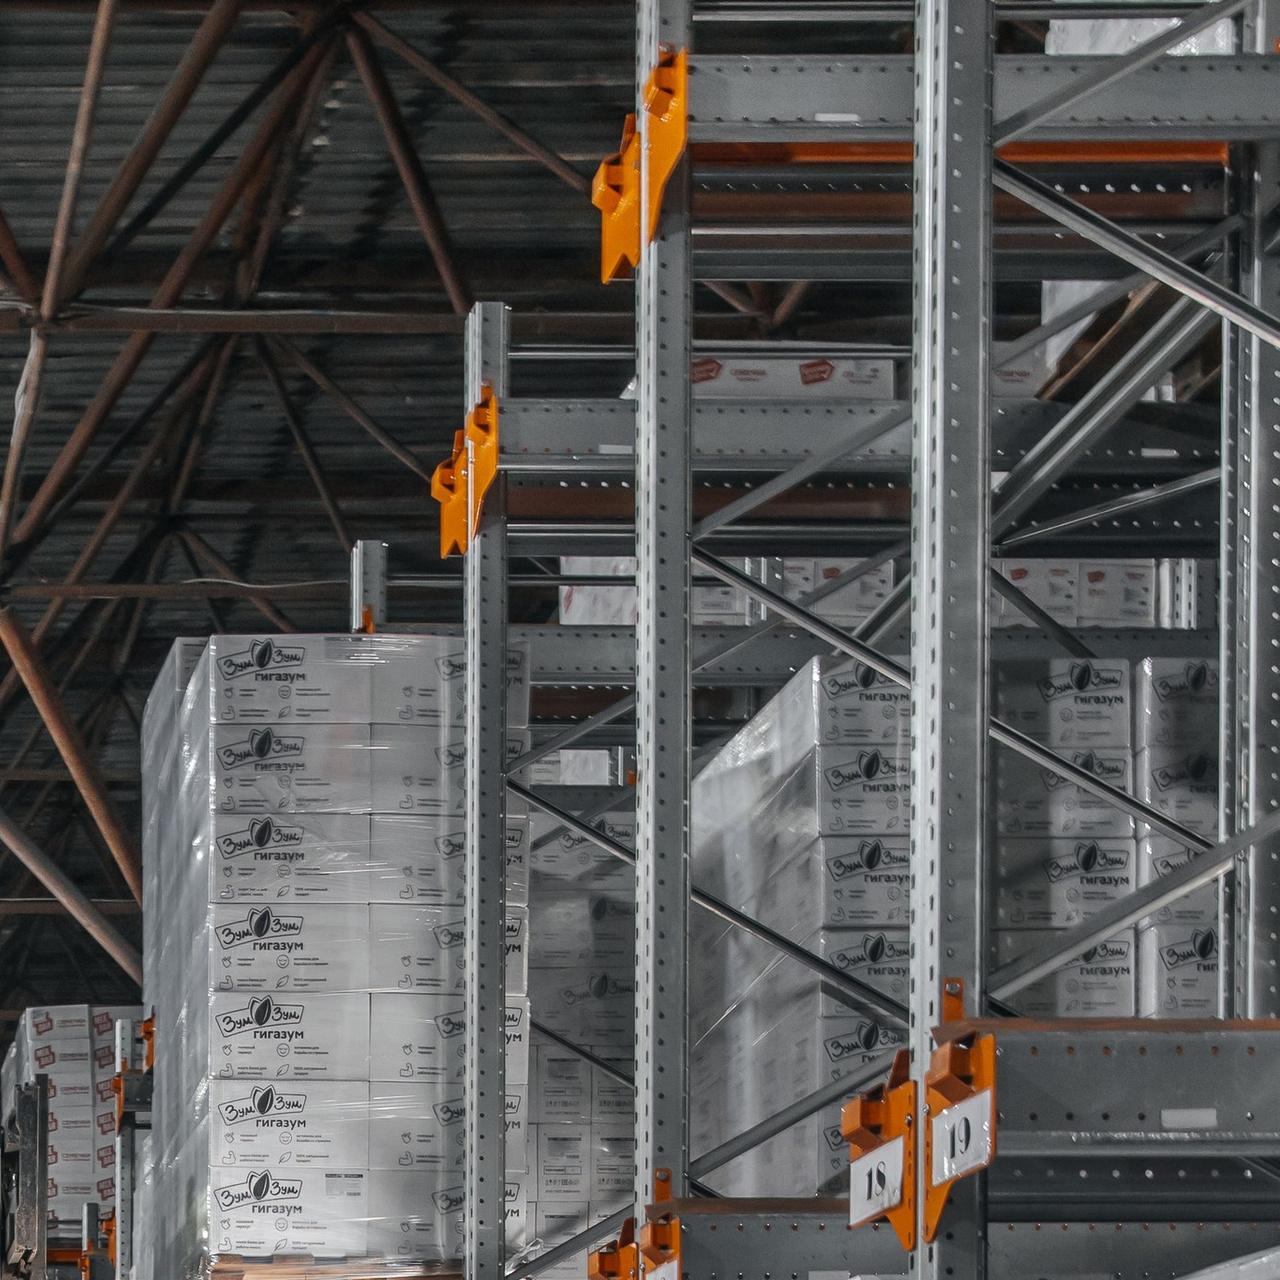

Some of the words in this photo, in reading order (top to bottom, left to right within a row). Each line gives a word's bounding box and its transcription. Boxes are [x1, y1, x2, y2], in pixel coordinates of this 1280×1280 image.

[224, 659, 254, 676] Зум
[272, 650, 301, 663] Зум
[254, 673, 306, 684] гигазум
[828, 678, 858, 696] Зум
[223, 749, 254, 766] Зум
[272, 739, 300, 754] Зум
[831, 770, 862, 787] Зум
[223, 838, 254, 854] Зум
[272, 828, 300, 842] Зум
[254, 852, 304, 863] гигазум
[833, 860, 862, 876] Зум
[1080, 876, 1130, 886] гигазум
[222, 928, 252, 944] Зум
[270, 918, 299, 932] Зум
[252, 942, 304, 953] гигазум
[867, 966, 910, 976] гигазу
[1080, 966, 1130, 978] гигазум
[222, 1016, 254, 1032] Зум
[272, 1007, 300, 1021] Зум
[254, 1030, 304, 1042] гигазум
[830, 1040, 860, 1057] Зум
[224, 1105, 256, 1122] Зум
[274, 1096, 302, 1110] Зум
[256, 1119, 306, 1130] гигазум
[948, 1117, 971, 1160] 19
[866, 1161, 886, 1200] 18
[220, 1190, 252, 1207] Зум
[270, 1182, 298, 1196] Зум
[252, 1204, 302, 1216] гигазум
